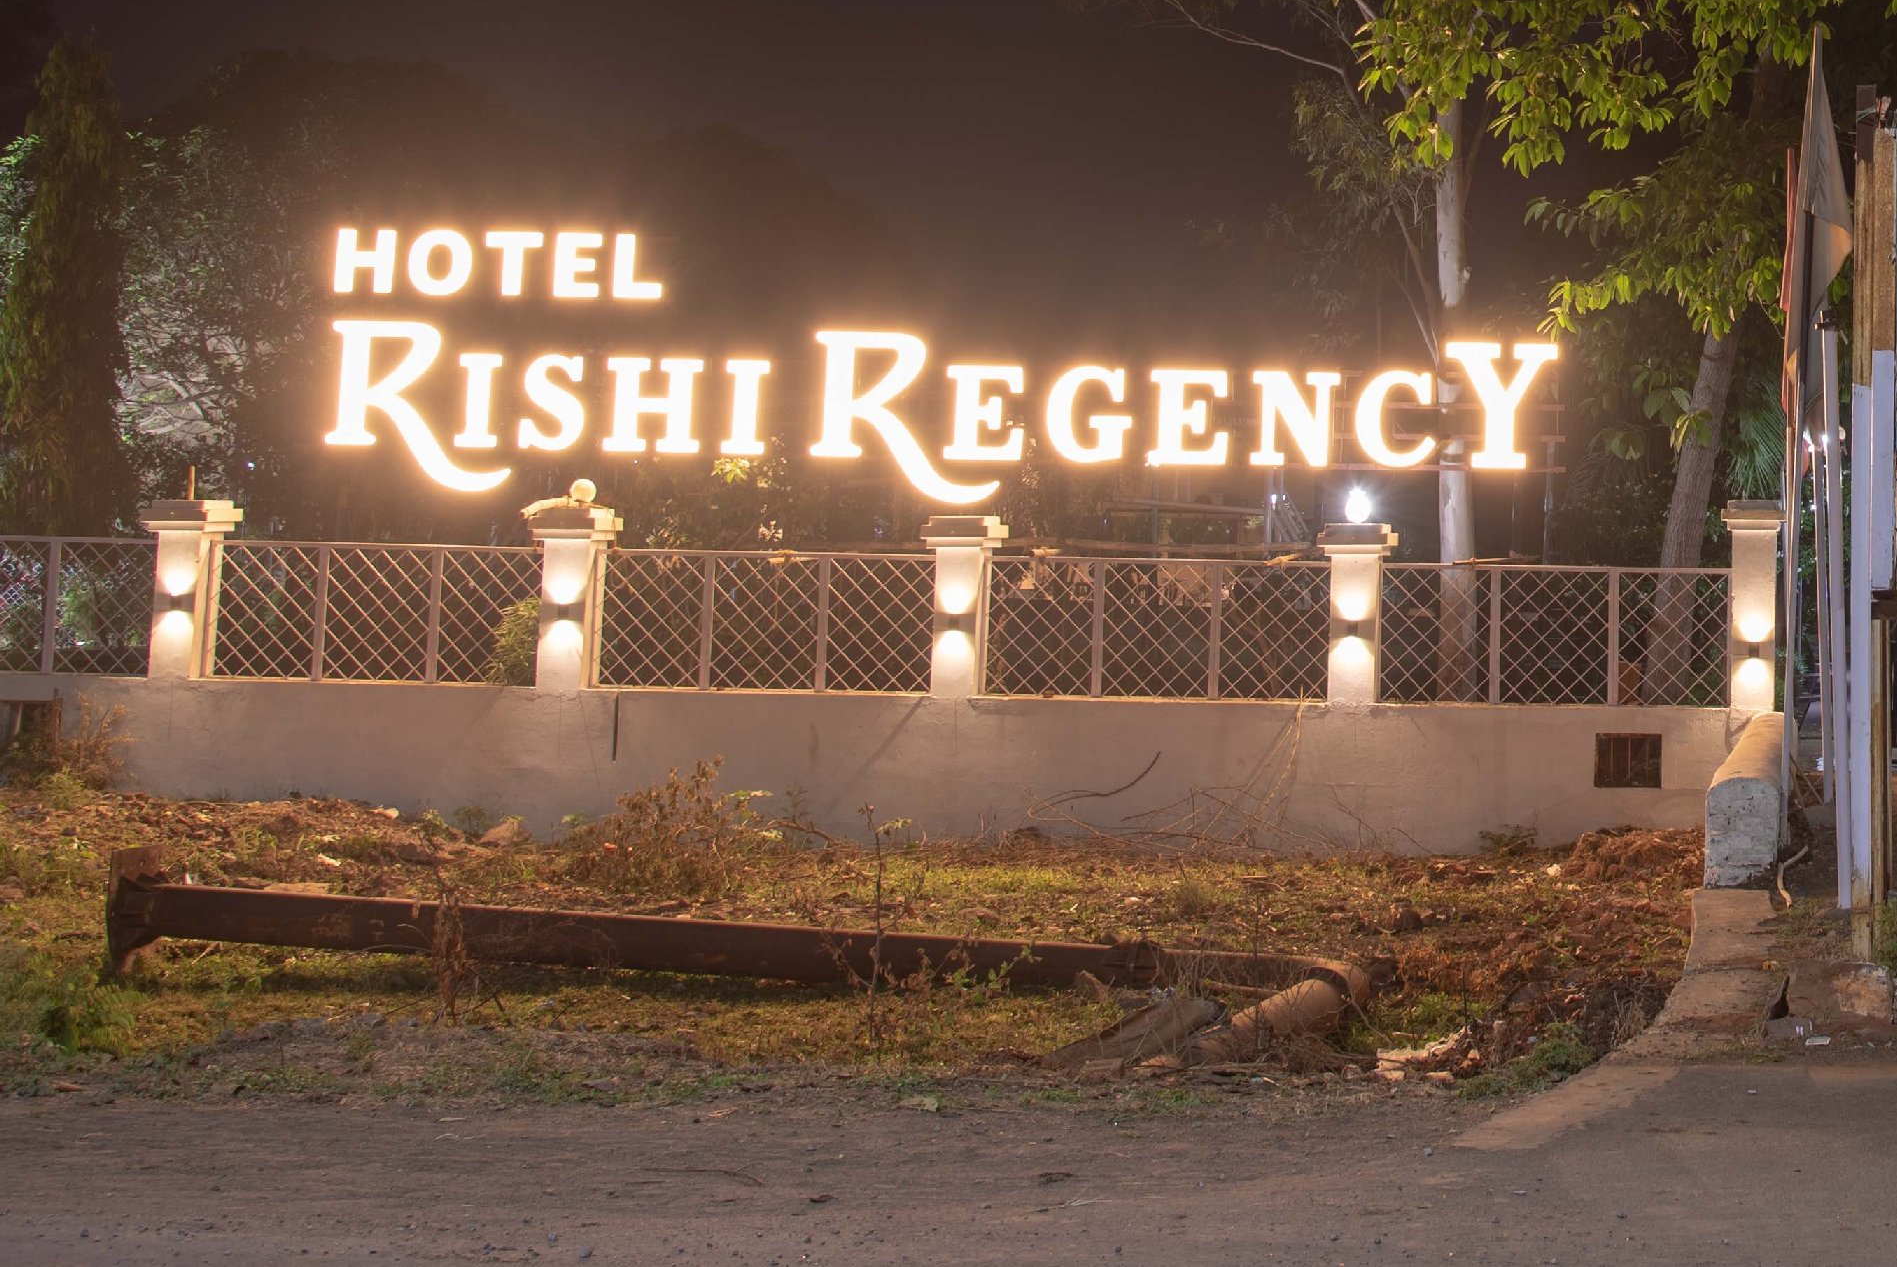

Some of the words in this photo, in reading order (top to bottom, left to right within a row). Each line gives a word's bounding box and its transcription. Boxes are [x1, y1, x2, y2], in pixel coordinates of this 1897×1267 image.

[332, 227, 664, 301] HOTEL
[323, 318, 773, 494] RISHI
[808, 329, 1560, 506] REGENCY
